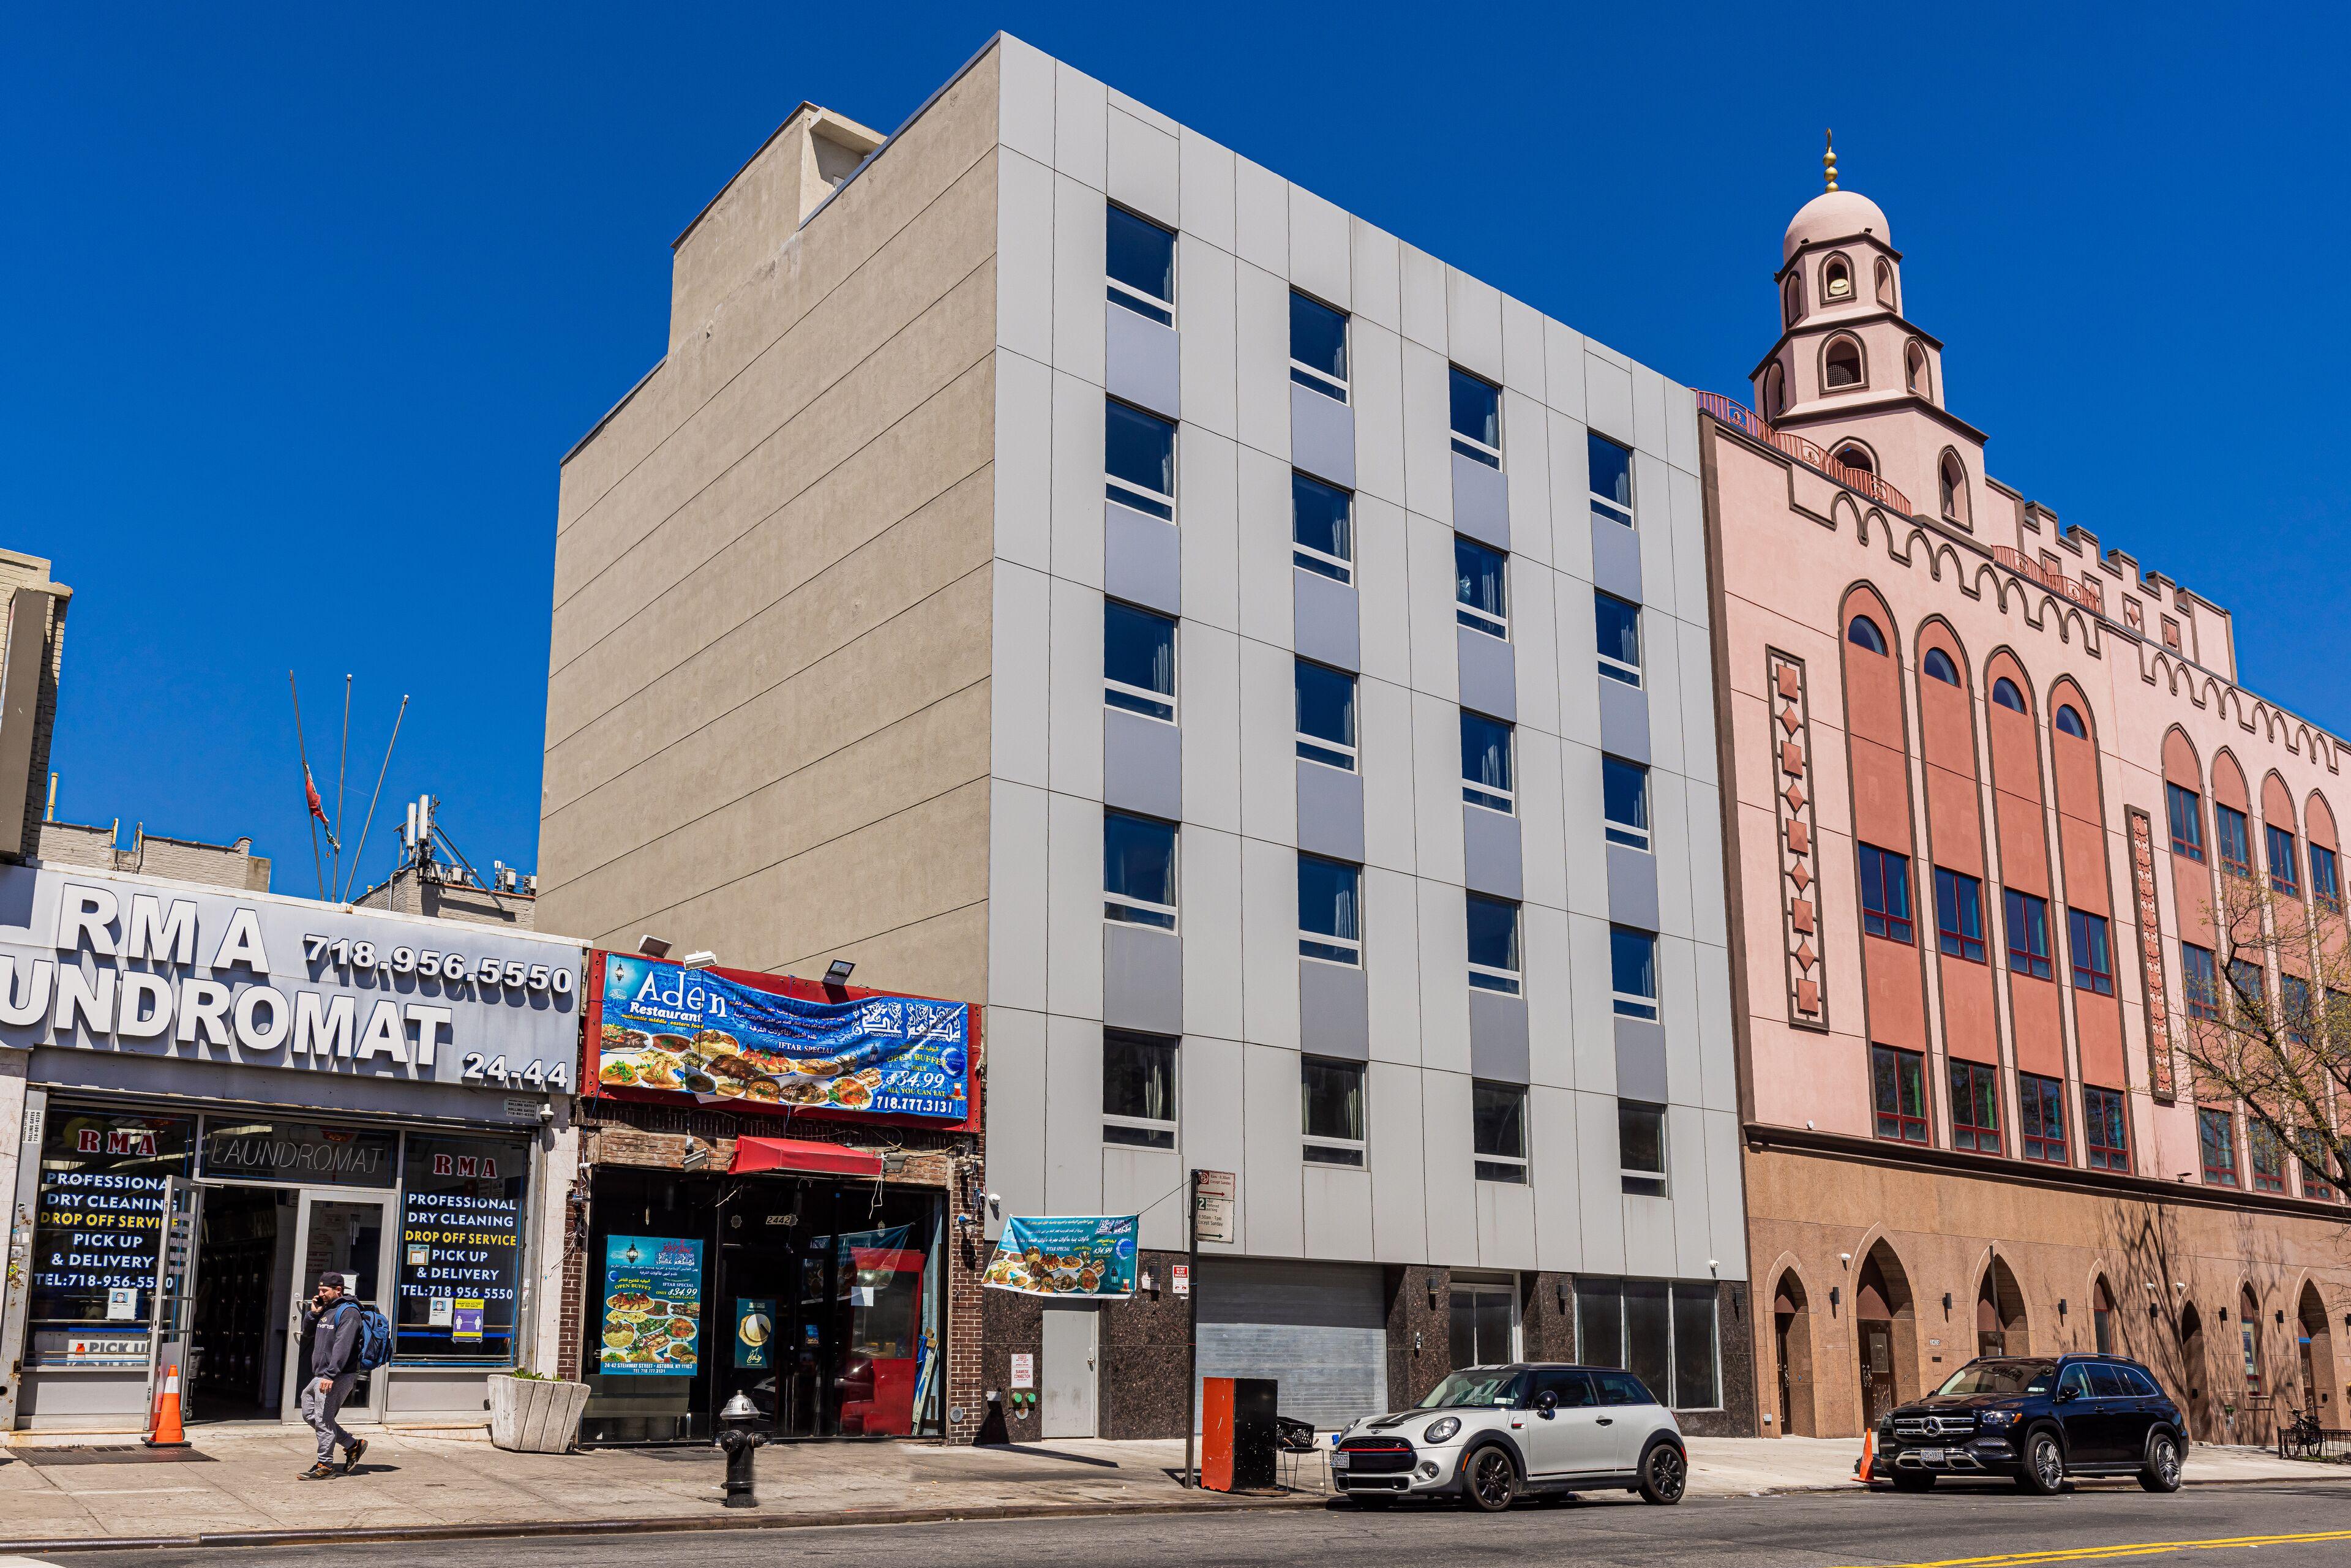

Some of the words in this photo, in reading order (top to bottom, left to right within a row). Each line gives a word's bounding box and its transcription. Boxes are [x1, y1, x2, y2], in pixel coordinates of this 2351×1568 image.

[304, 933, 573, 994] 718.956.5550
[633, 970, 727, 1018] Aden
[0, 954, 452, 1066] UNDROMAT
[629, 1002, 703, 1023] Restaurant
[778, 1041, 801, 1051] IFTAR
[804, 1045, 834, 1054] SPECIAL
[887, 1054, 912, 1063] OPEN
[915, 1054, 948, 1067] BUFFET
[463, 1051, 569, 1087] 24-44
[886, 1071, 945, 1088] $34.99
[877, 1096, 952, 1113] 718.777.3131
[212, 1138, 384, 1173] LAUNDROMAT
[47, 1172, 167, 1190] PROFESSIONA
[47, 1193, 83, 1206] DRY
[408, 1194, 516, 1210] PROFESSIONAL
[1198, 1198, 1204, 1209] 2
[40, 1212, 83, 1225] DROP
[86, 1214, 115, 1226] OFF
[408, 1212, 438, 1223] DRY
[440, 1214, 514, 1227] CLEANING
[74, 1234, 114, 1247] PICK
[120, 1236, 143, 1248] UP
[405, 1230, 440, 1242] DROP
[442, 1232, 465, 1244] OFF
[468, 1233, 517, 1246] SERVICE
[52, 1253, 64, 1266] &
[69, 1254, 154, 1268] DELIVERY
[432, 1250, 465, 1261] PICK
[470, 1251, 488, 1262] UP
[416, 1267, 427, 1278] &
[431, 1267, 500, 1280] DELIVERY
[667, 1288, 698, 1296] $34.99
[89, 1342, 129, 1352] PICK
